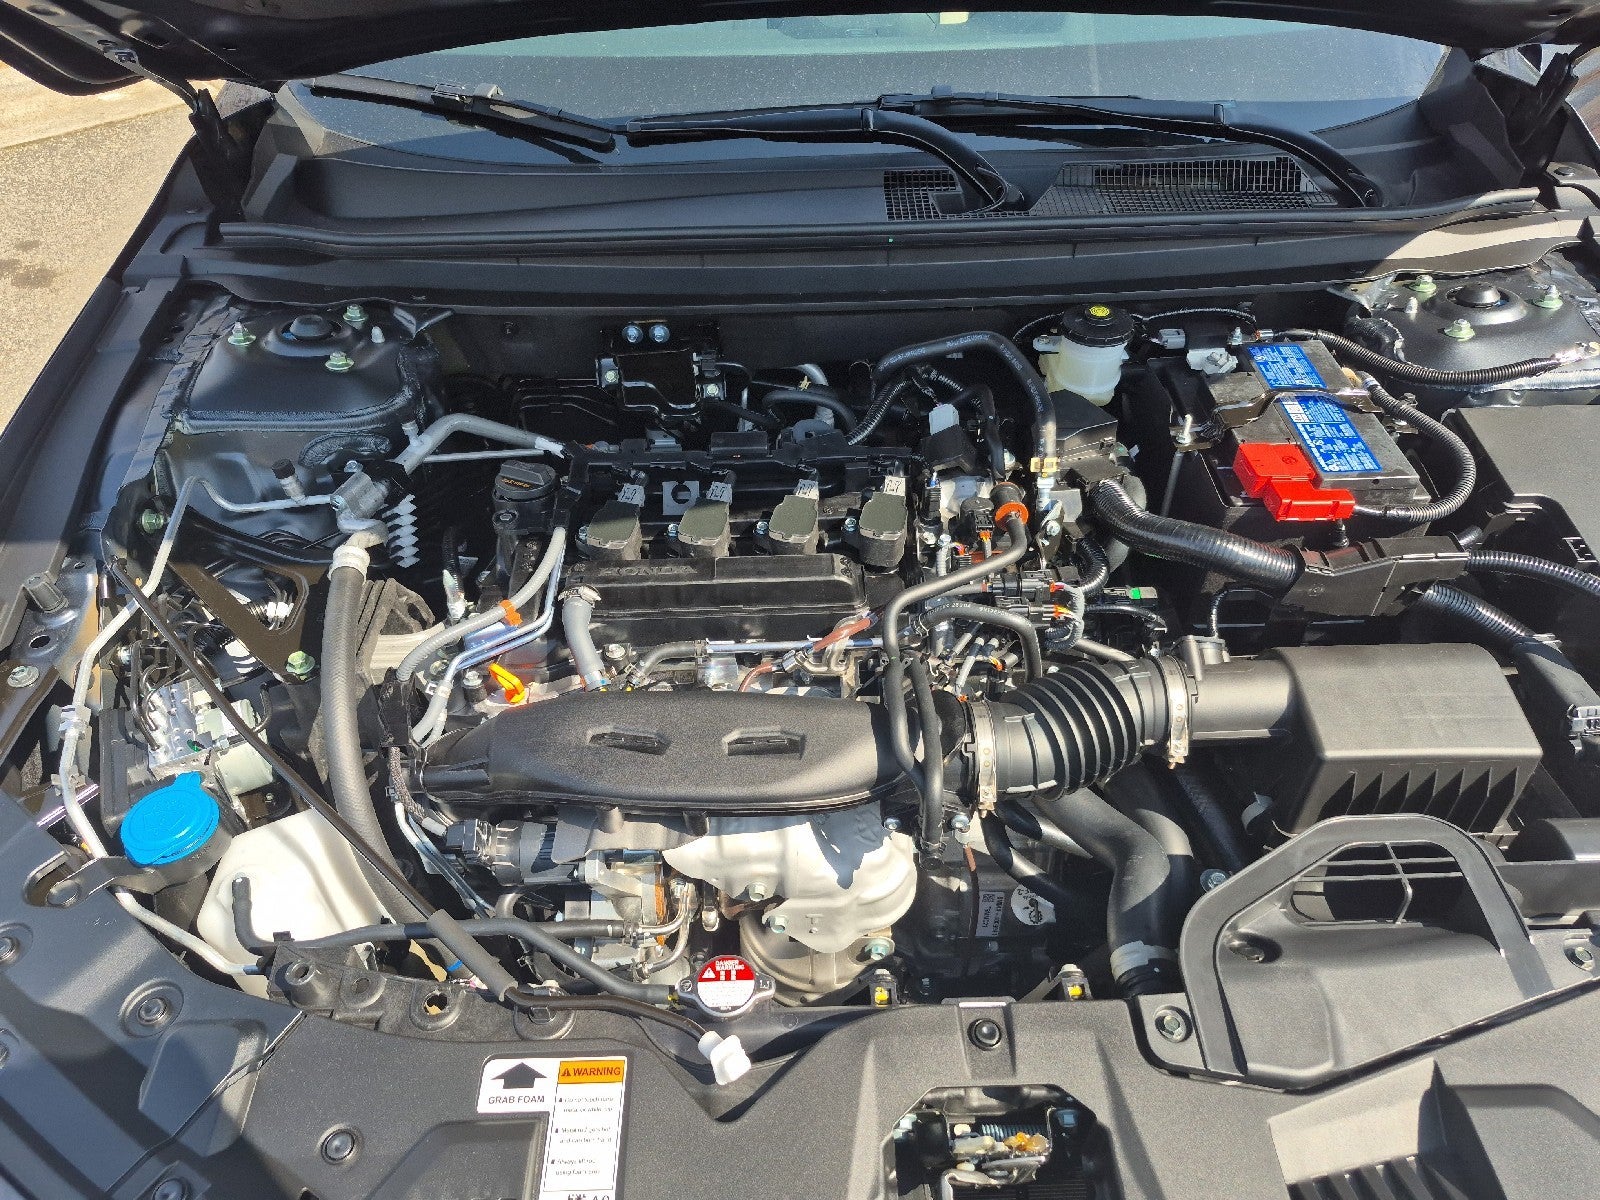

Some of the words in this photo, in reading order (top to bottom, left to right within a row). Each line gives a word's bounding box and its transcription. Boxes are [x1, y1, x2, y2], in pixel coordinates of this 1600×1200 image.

[573, 1067, 621, 1077] WARNING
[488, 1095, 515, 1104] GRAB
[517, 1095, 545, 1104] FOAM
